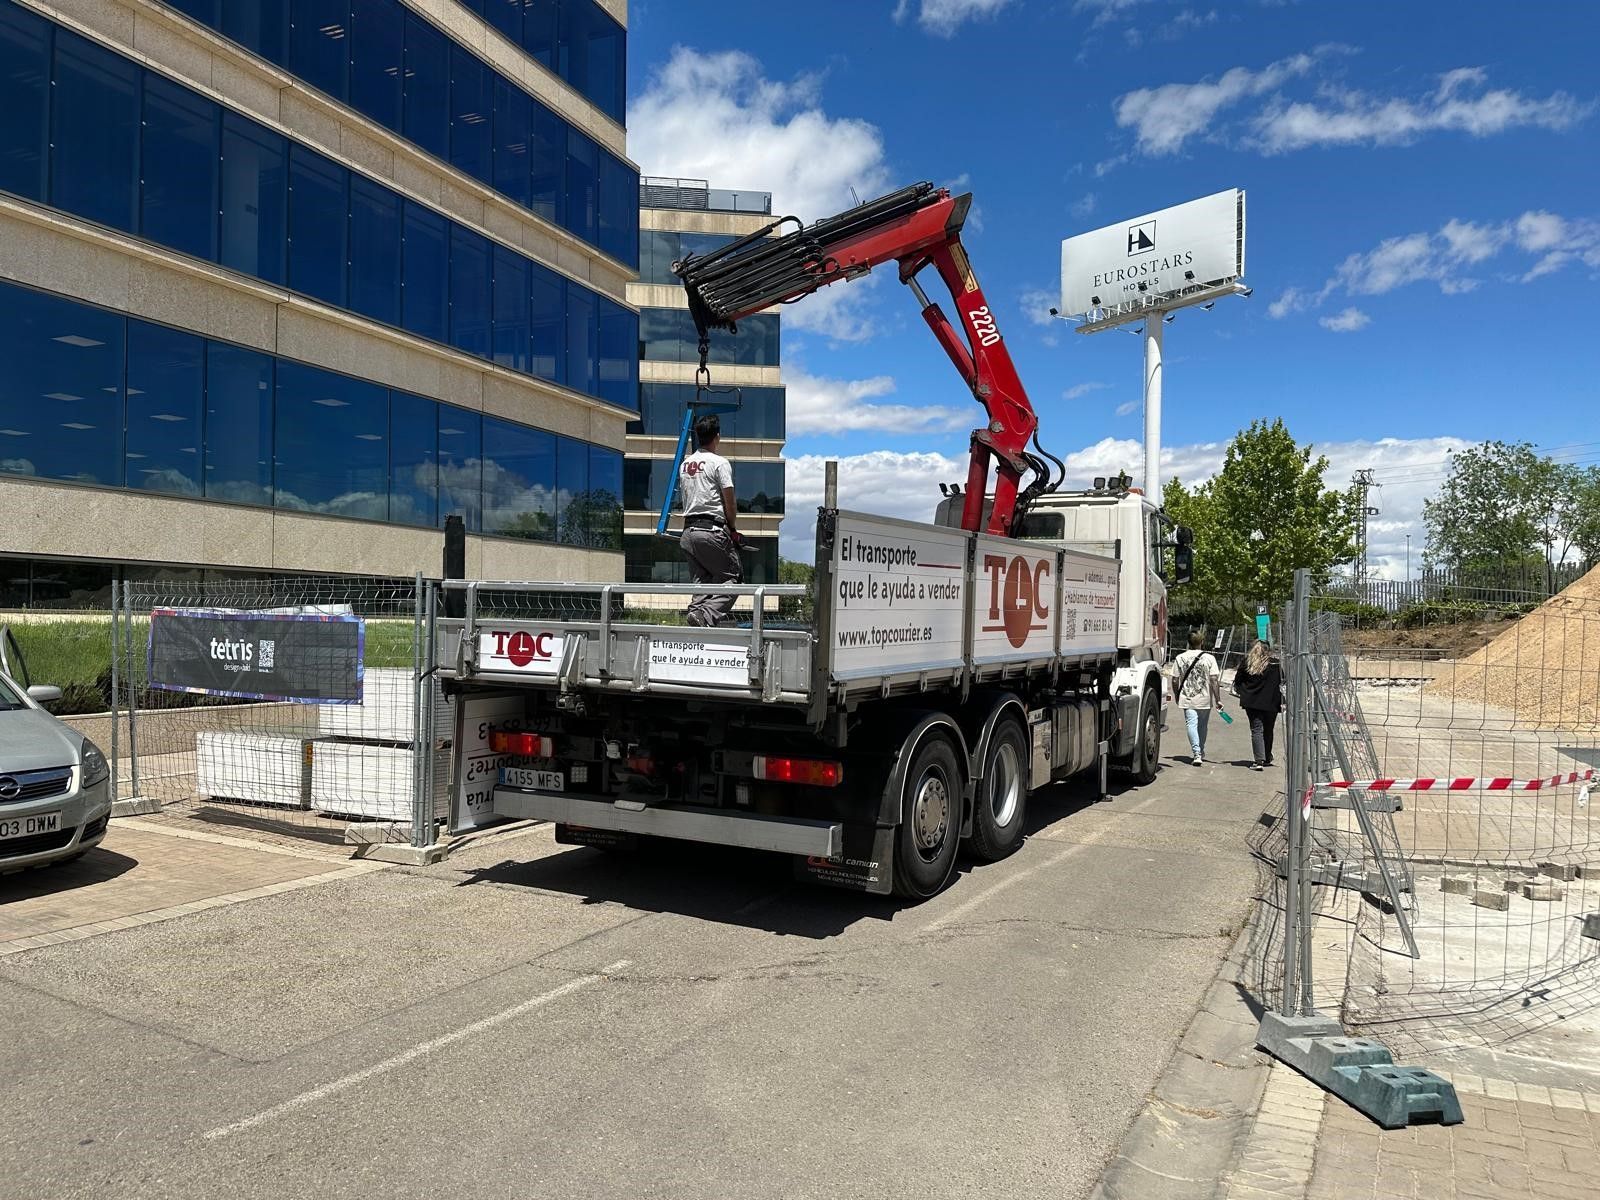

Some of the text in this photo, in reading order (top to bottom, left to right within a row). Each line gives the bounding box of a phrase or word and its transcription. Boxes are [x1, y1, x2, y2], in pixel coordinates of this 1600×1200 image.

[1093, 251, 1193, 288] EUROSTARS
[969, 305, 1000, 347] 2220
[842, 536, 917, 571] El transporte
[840, 573, 960, 607] que le ayuda a vender
[984, 554, 1050, 649] TOC
[210, 637, 253, 661] tetris
[491, 631, 555, 668] TOC
[653, 639, 705, 652] El transporte
[839, 622, 932, 650] www.topcourier.es
[651, 653, 746, 668] que le ayuda a vender
[506, 769, 561, 788] 4155 MFS
[26, 815, 57, 833] DWM
